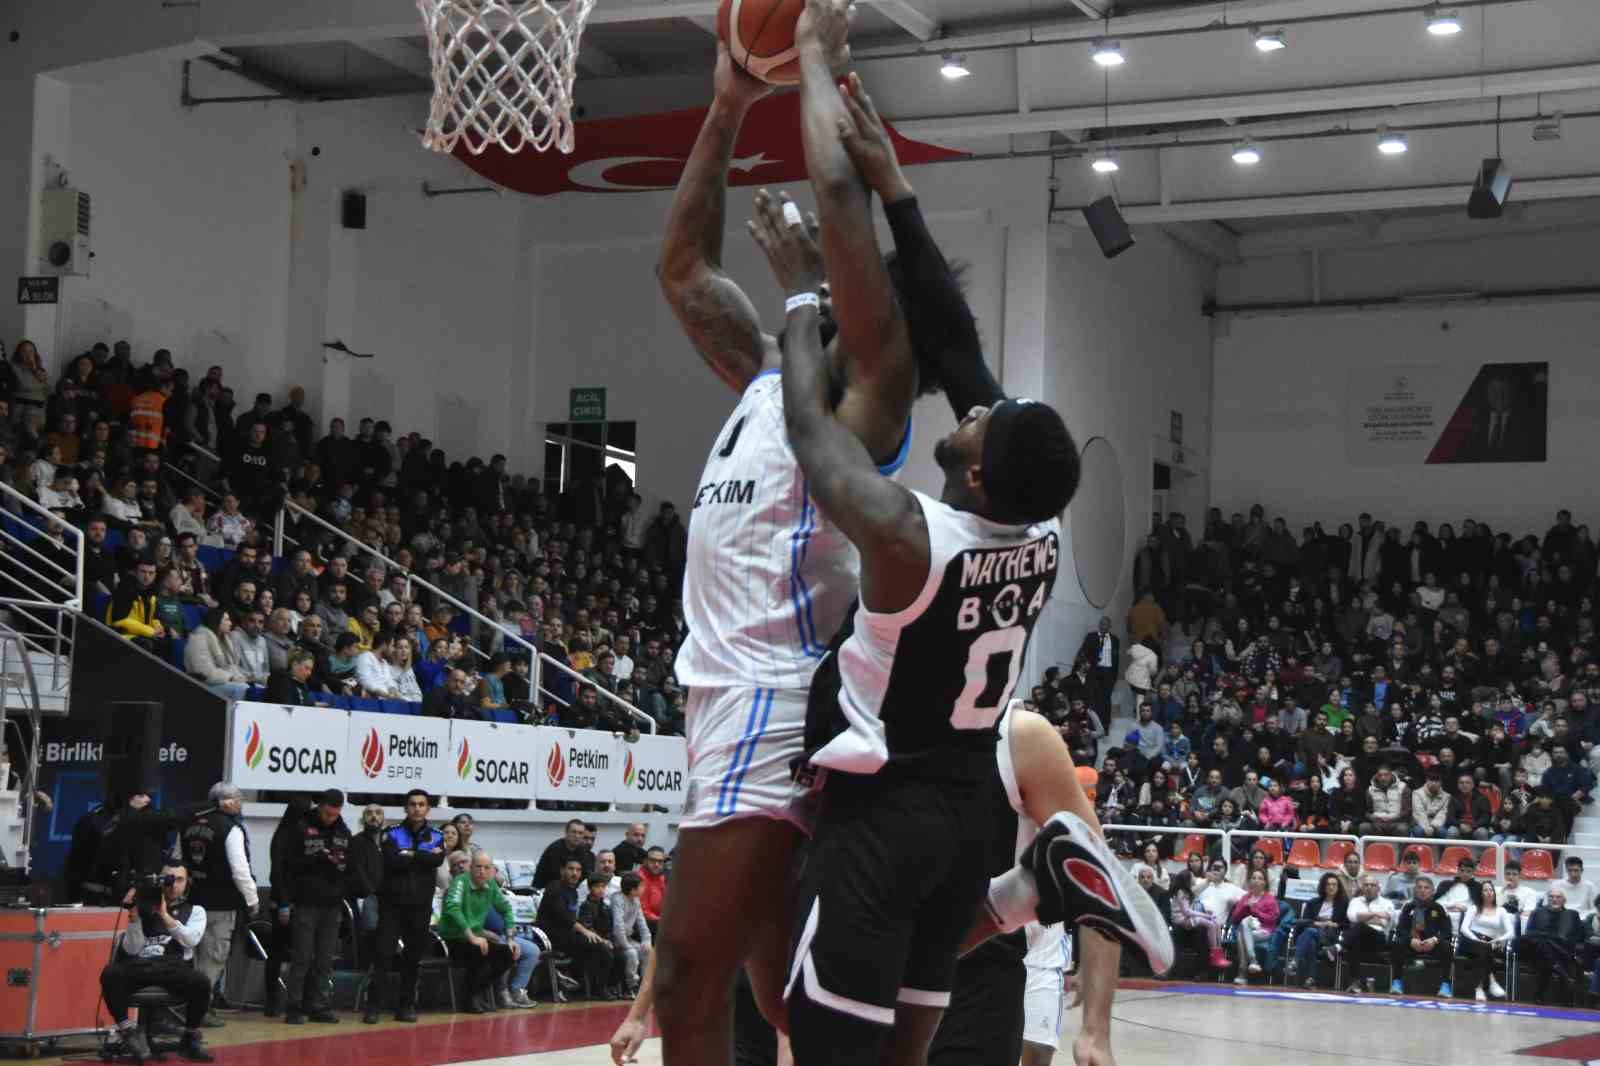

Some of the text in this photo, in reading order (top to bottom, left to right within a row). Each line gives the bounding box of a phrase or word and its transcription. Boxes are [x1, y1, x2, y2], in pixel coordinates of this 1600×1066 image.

[960, 533, 1057, 588] MATHEWS
[950, 624, 1027, 730] 0
[46, 742, 188, 762] Birlikt efe
[389, 734, 438, 759] Petkim
[268, 745, 337, 775] SOCAR
[475, 758, 529, 784] SOCAR
[569, 747, 609, 771] Petkim
[387, 765, 423, 780] SPOR
[568, 775, 597, 789] SPOR
[637, 768, 683, 792] SOCAR
